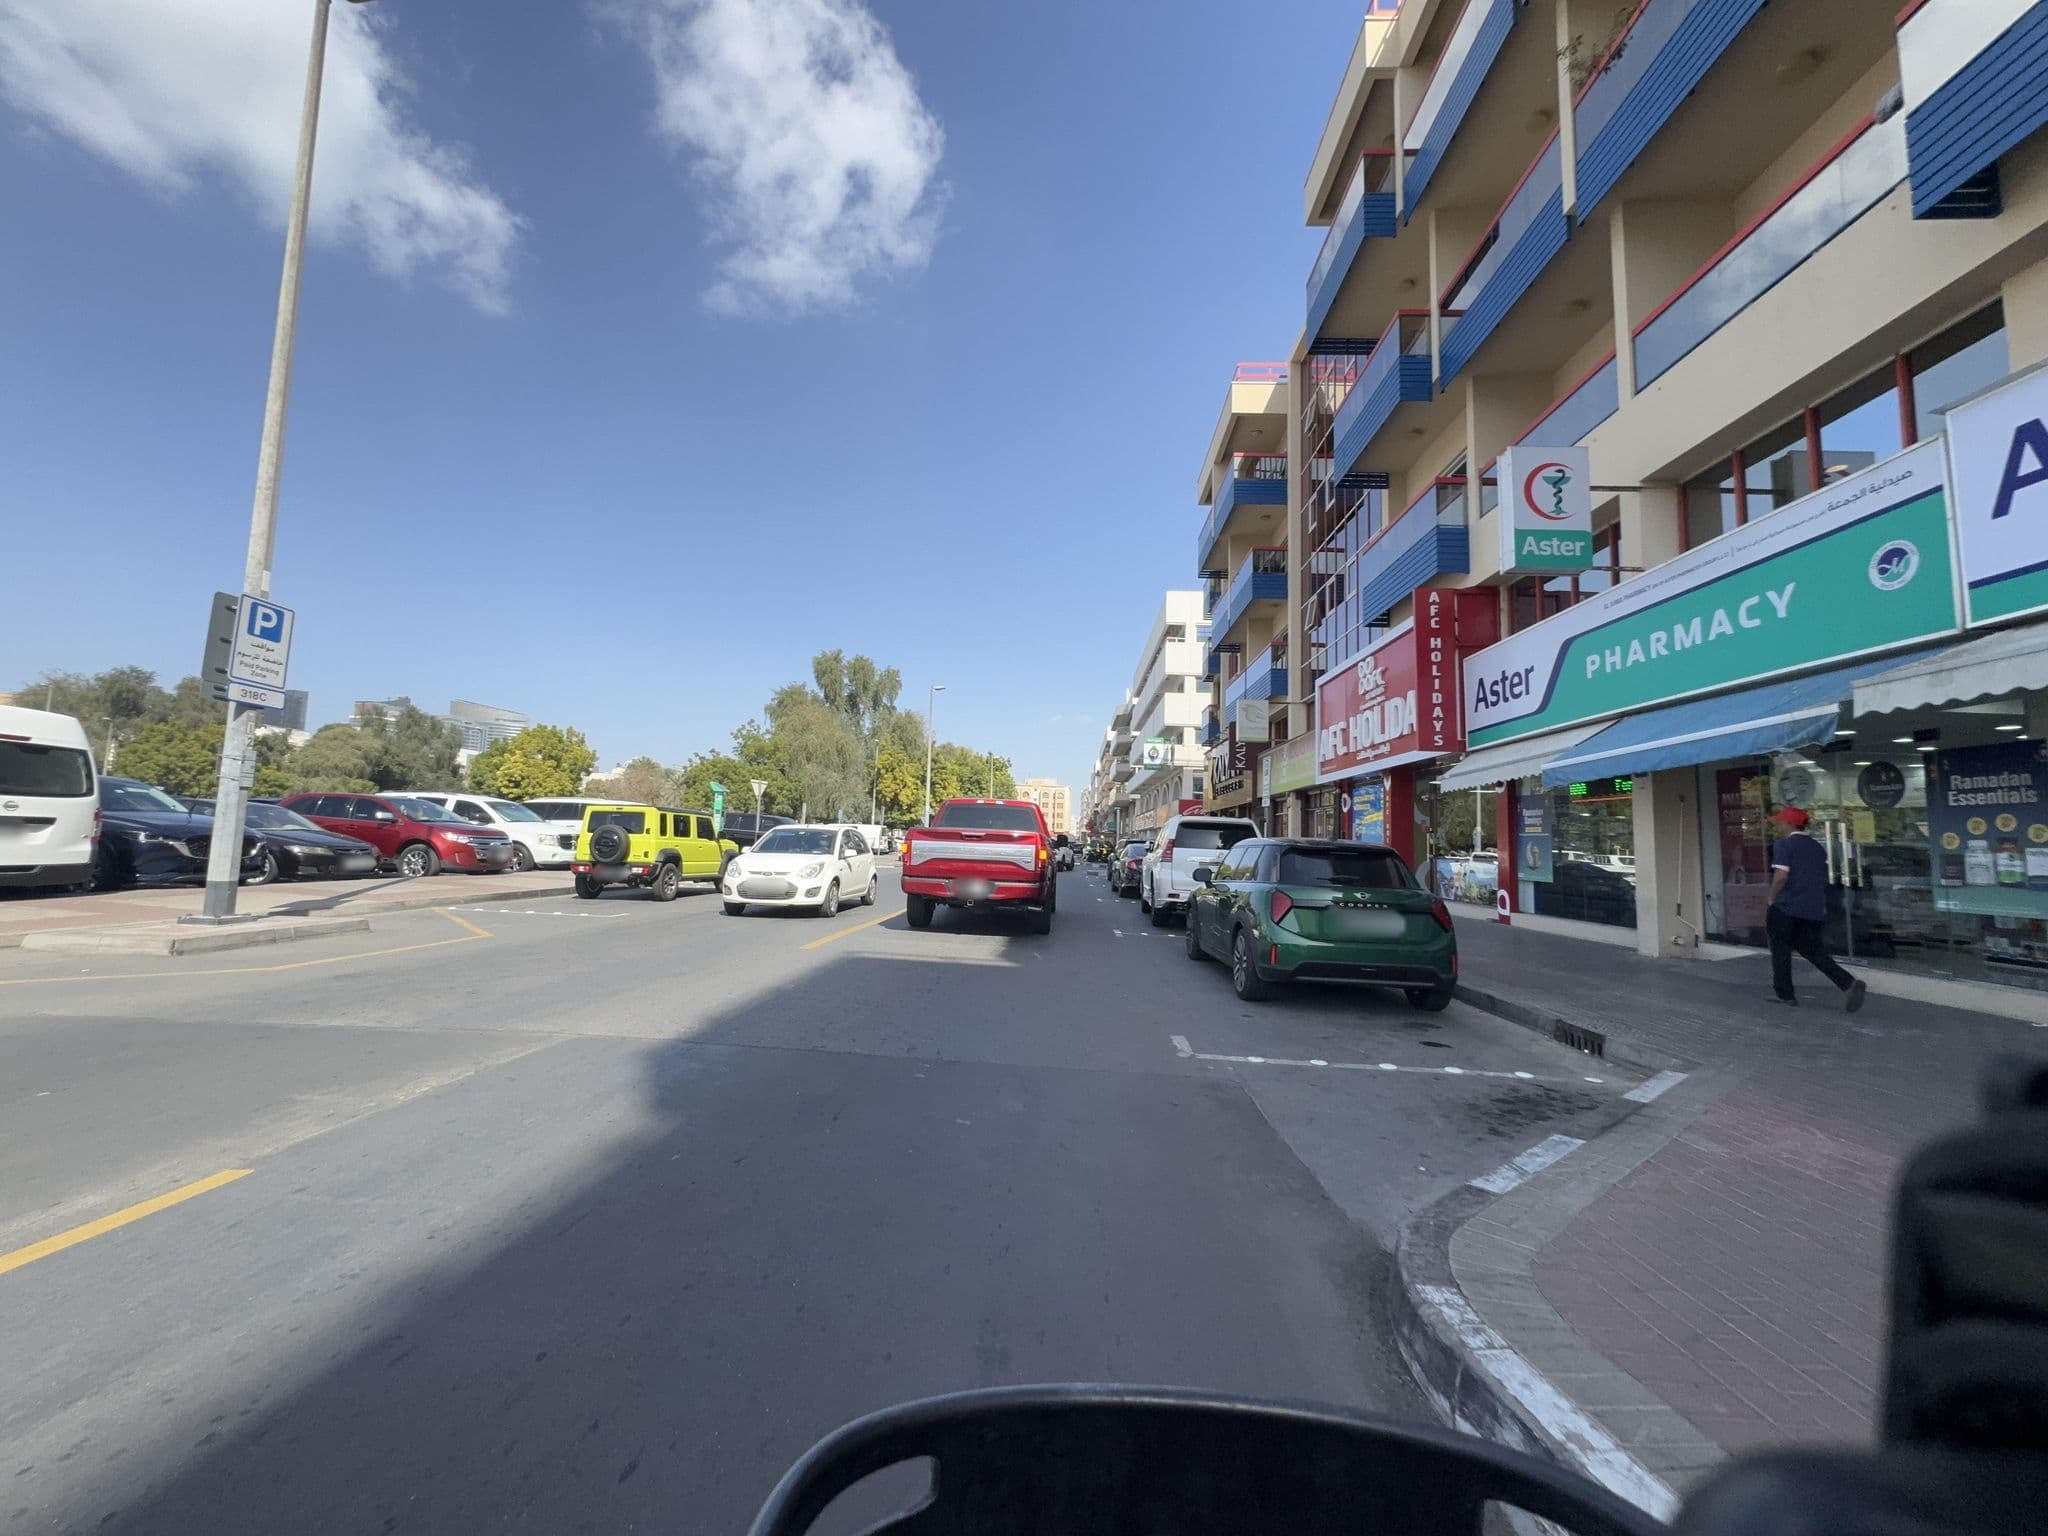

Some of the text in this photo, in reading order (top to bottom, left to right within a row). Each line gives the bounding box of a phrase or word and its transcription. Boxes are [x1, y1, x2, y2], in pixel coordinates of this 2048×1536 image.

[1868, 469, 1913, 494] صيدلية
[1522, 536, 1585, 557] Aster
[254, 605, 278, 636] P
[1585, 582, 1797, 679] PHARMACY
[239, 660, 280, 677] Paid Parking
[250, 669, 267, 679] Zone
[1428, 591, 1444, 746] AFC HOLIDAYS
[240, 688, 267, 702] 318C
[1474, 664, 1535, 713] Aster
[1319, 689, 1417, 763] AFC HOLIDA
[1235, 741, 1246, 768] KALY
[1950, 771, 2032, 790] Ramadan
[1948, 787, 2039, 806] Essentials
